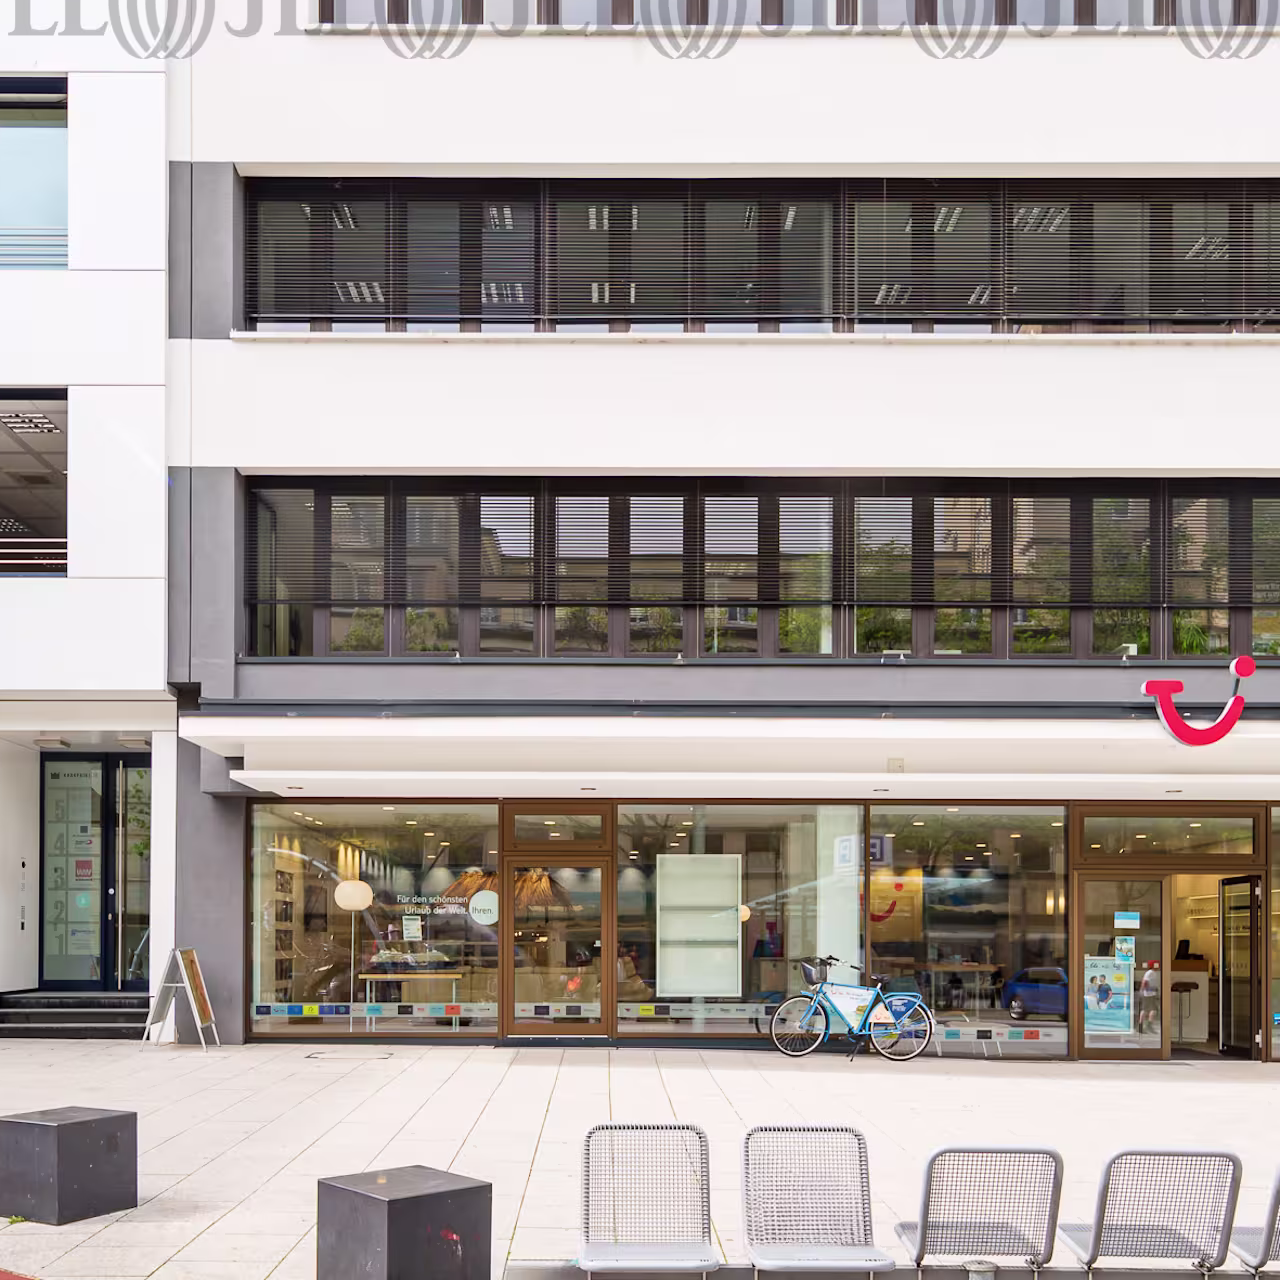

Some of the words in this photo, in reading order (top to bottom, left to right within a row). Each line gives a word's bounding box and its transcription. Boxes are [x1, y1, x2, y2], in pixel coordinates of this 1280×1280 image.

[397, 895, 410, 903] Für
[412, 895, 427, 903] den
[428, 895, 468, 903] schönsten
[404, 906, 432, 915] Urlaub
[472, 906, 494, 914] Ihren.
